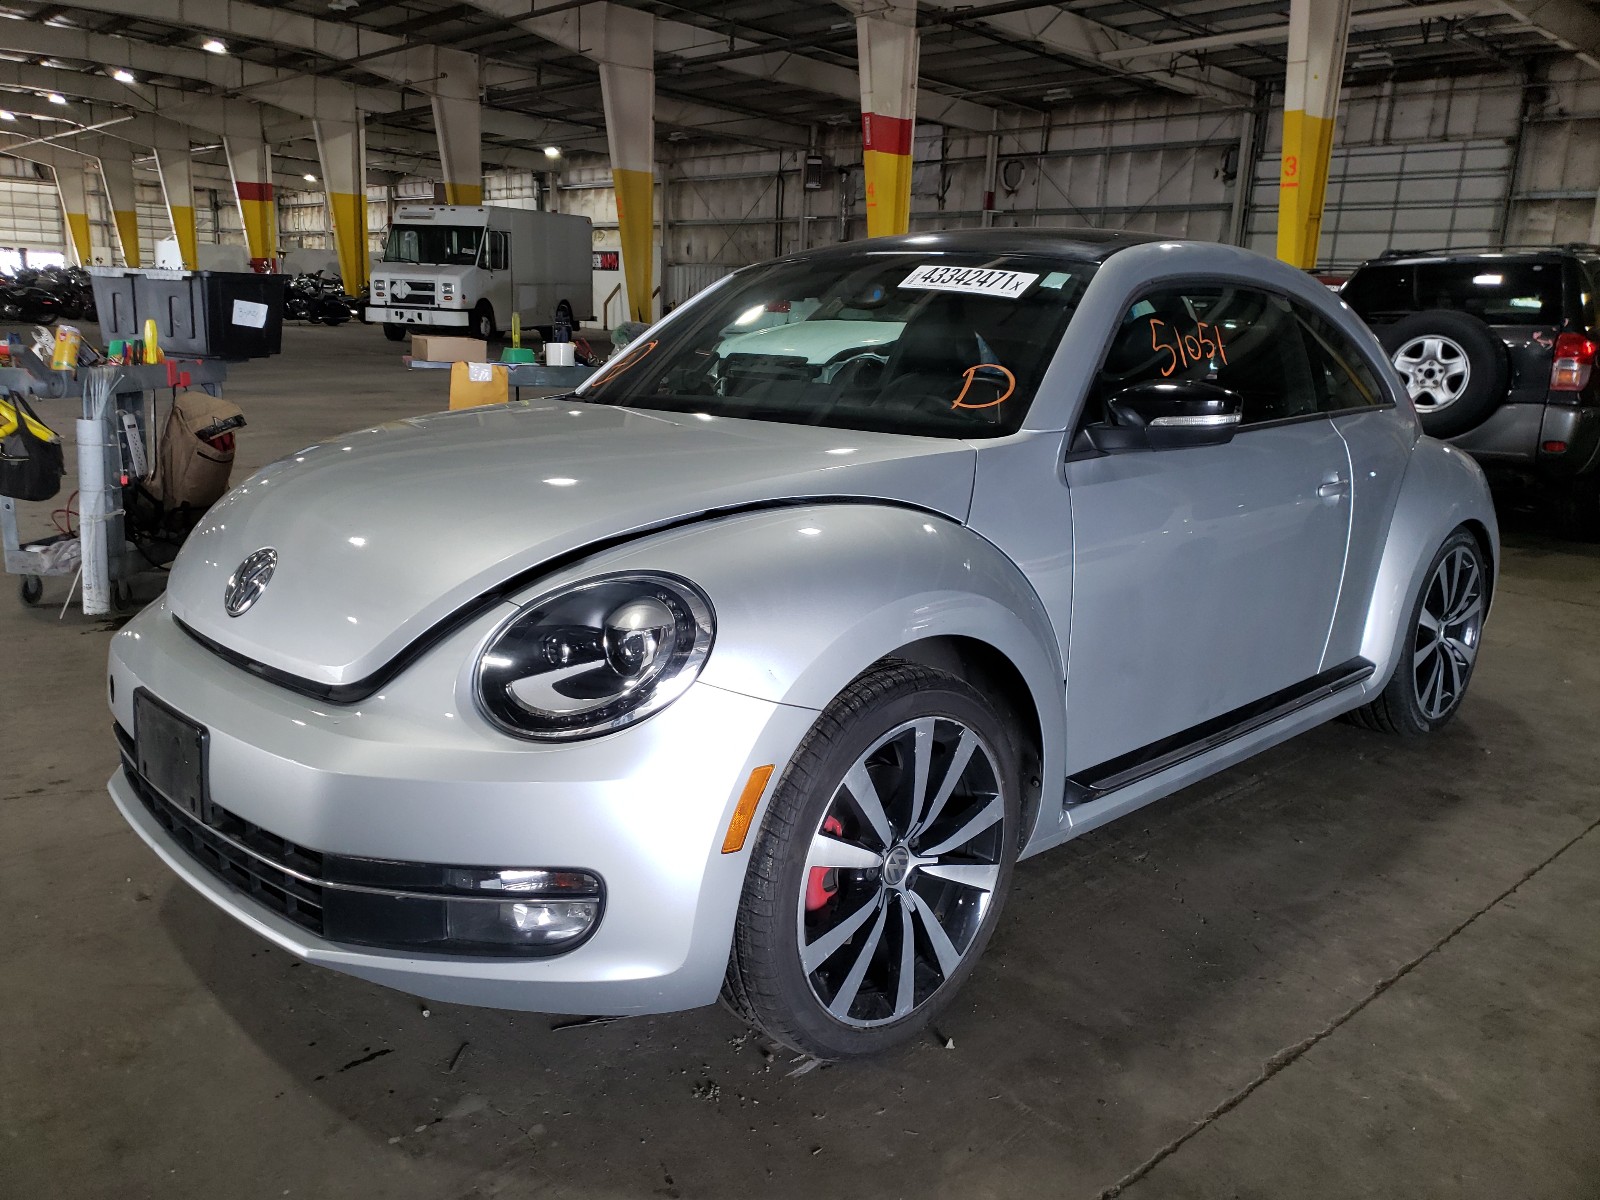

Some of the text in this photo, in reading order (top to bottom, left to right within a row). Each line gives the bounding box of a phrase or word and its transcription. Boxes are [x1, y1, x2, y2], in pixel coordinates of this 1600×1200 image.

[1284, 156, 1298, 177] 3
[867, 181, 875, 198] 4
[1149, 318, 1229, 377] 51051
[950, 363, 1016, 410] D
